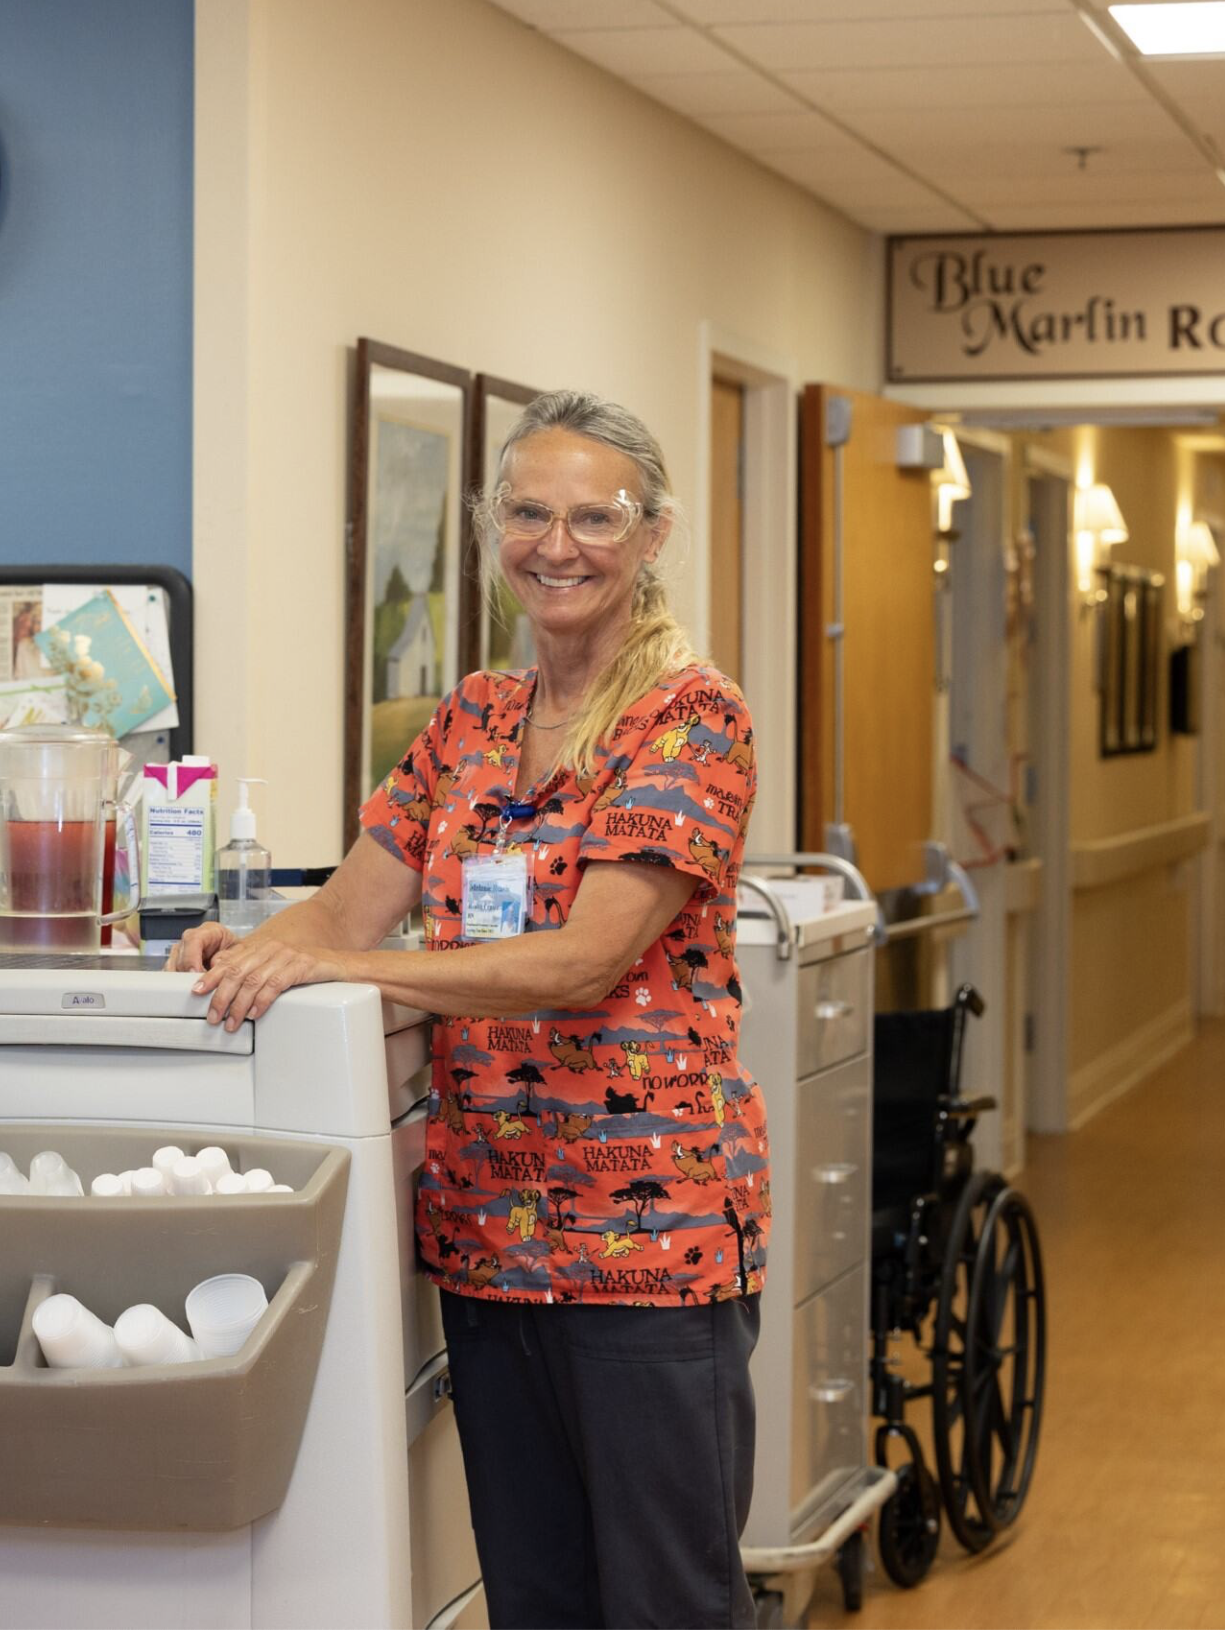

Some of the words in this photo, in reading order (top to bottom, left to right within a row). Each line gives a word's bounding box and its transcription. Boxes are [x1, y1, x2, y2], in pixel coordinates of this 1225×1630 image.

[909, 249, 1045, 314] Blue
[961, 296, 1147, 356] Marlin
[605, 813, 673, 831] HAKUNA
[604, 825, 668, 842] MATATA
[487, 1026, 533, 1041] HAKUNA
[487, 1038, 532, 1053] MATATA
[488, 1151, 546, 1168] HAKUN
[583, 1144, 654, 1160] HAKUNA
[491, 1165, 548, 1182] MATAT
[586, 1158, 652, 1172] MATATA
[590, 1267, 673, 1284] HAKUNA
